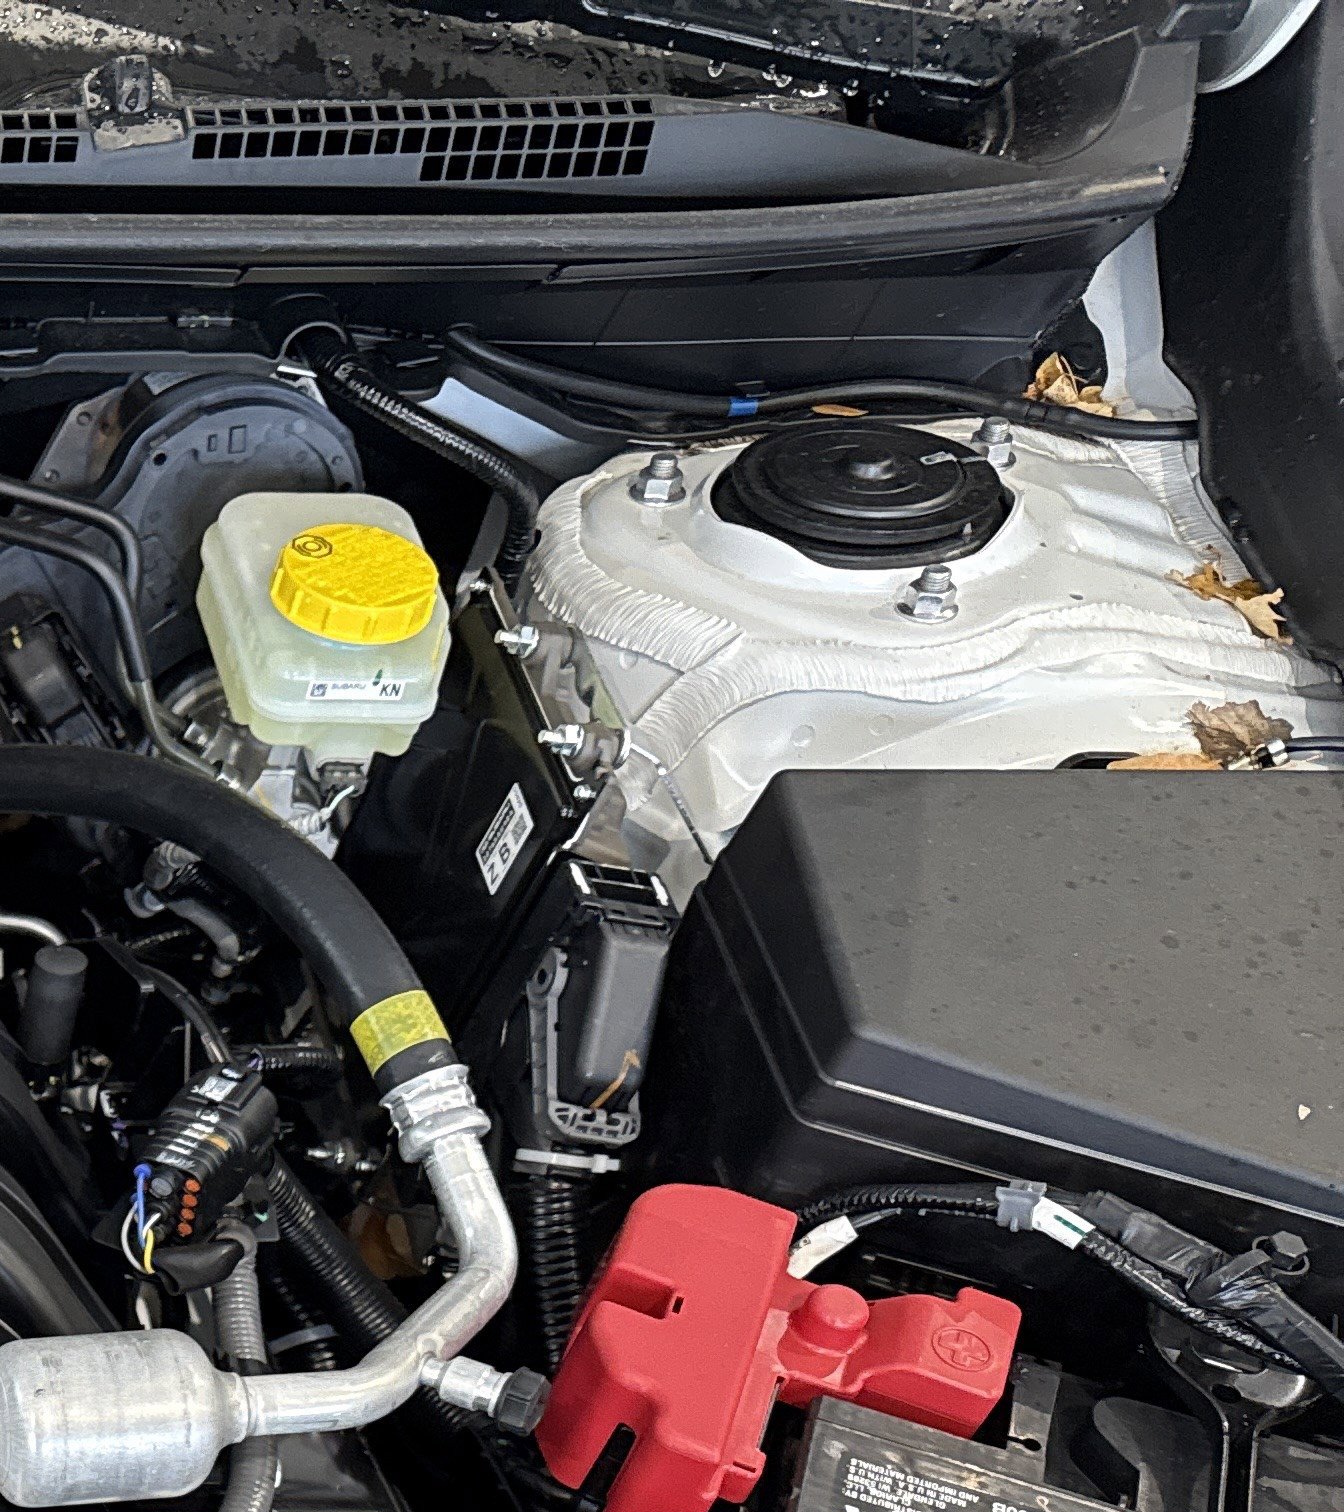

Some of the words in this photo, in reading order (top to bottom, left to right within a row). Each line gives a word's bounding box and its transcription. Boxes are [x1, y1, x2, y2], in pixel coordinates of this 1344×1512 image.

[378, 683, 402, 697] KN
[850, 1457, 905, 1481] MATERIALS
[868, 1471, 893, 1486] WITH
[906, 1474, 957, 1497] IMPORTED
[878, 1481, 891, 1493] WI
[926, 1489, 937, 1499] IN
[939, 1494, 967, 1508] MADE
[958, 1491, 980, 1504] AND
